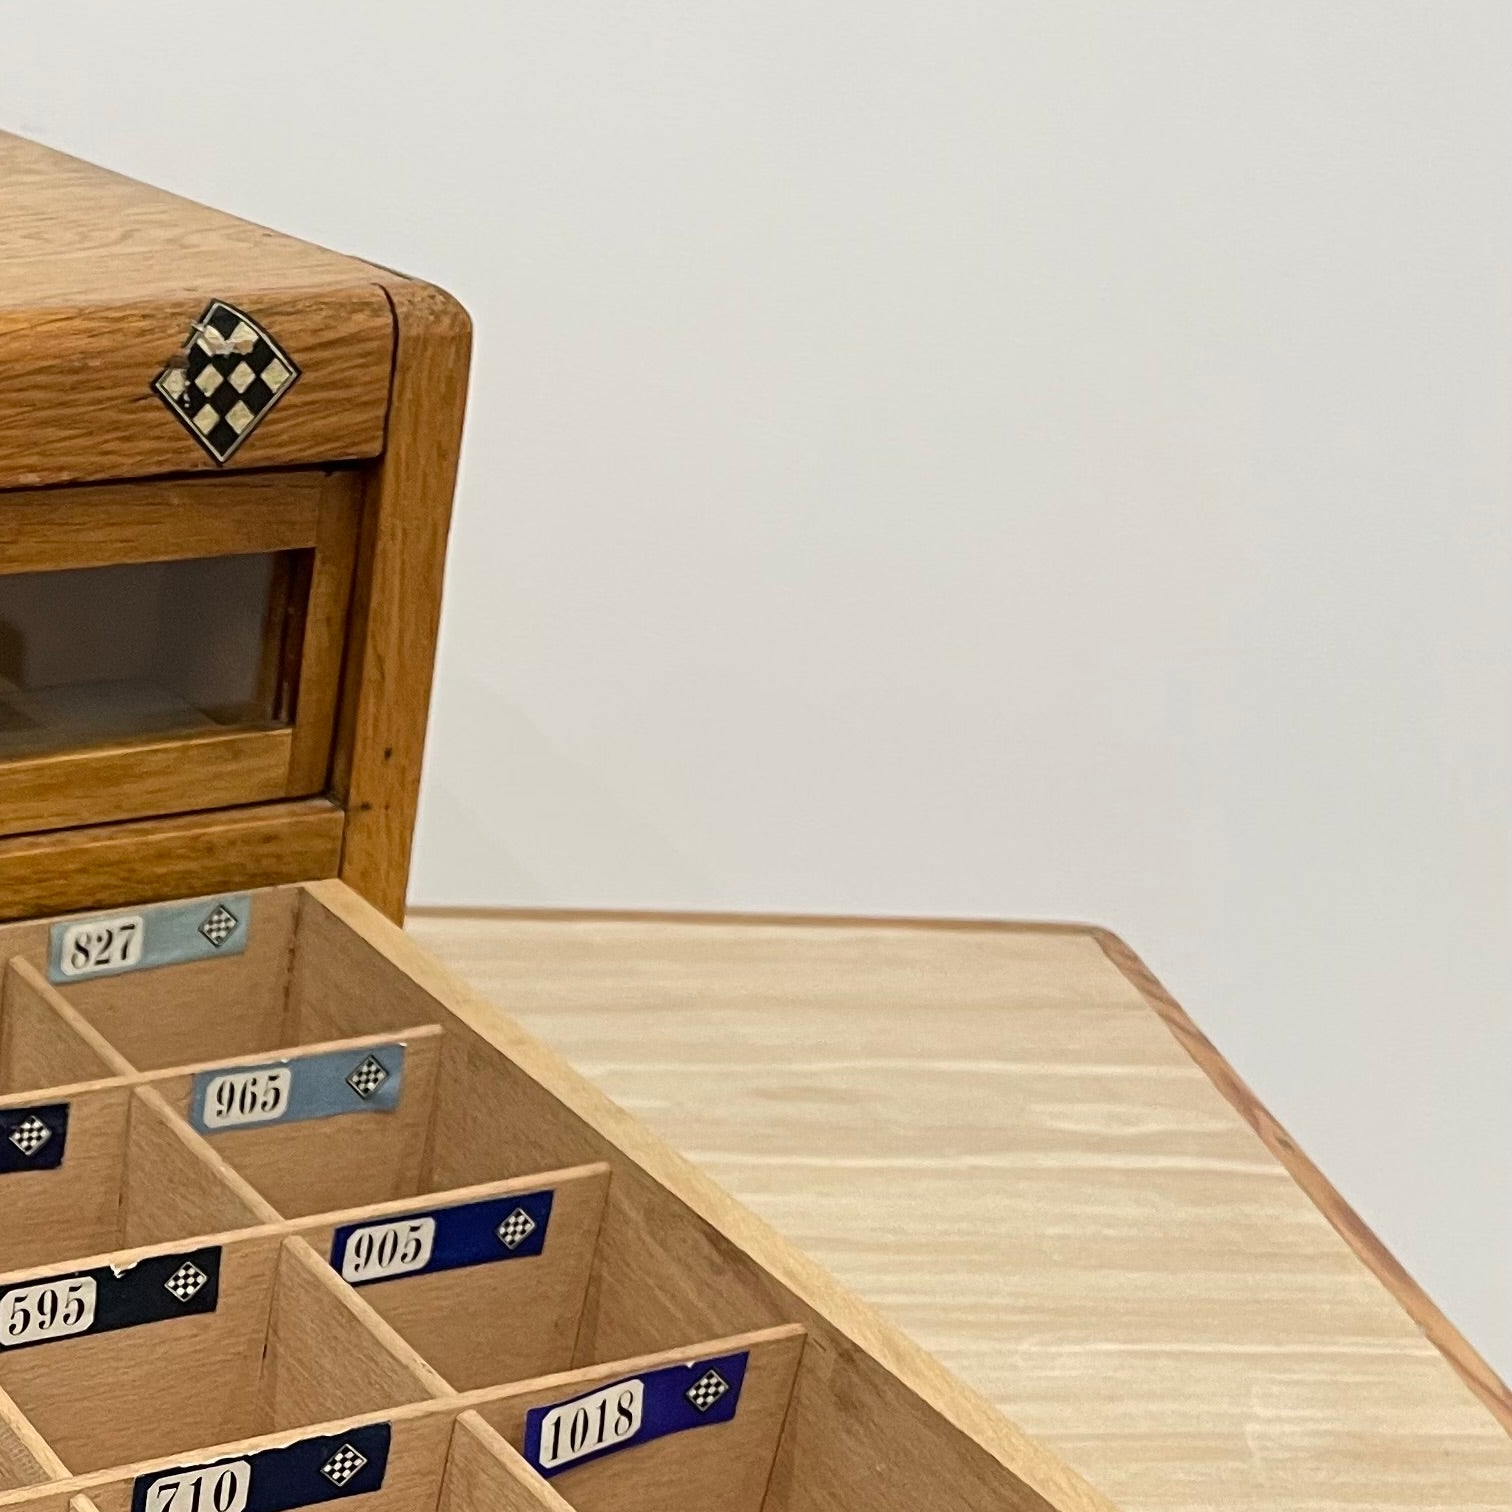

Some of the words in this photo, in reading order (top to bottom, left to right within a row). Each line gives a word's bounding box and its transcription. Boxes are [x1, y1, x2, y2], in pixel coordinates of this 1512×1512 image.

[70, 923, 137, 969] 827
[216, 1074, 281, 1118] 965
[354, 1225, 422, 1273] 905
[8, 1284, 85, 1336] 595
[550, 1390, 634, 1461] 1018
